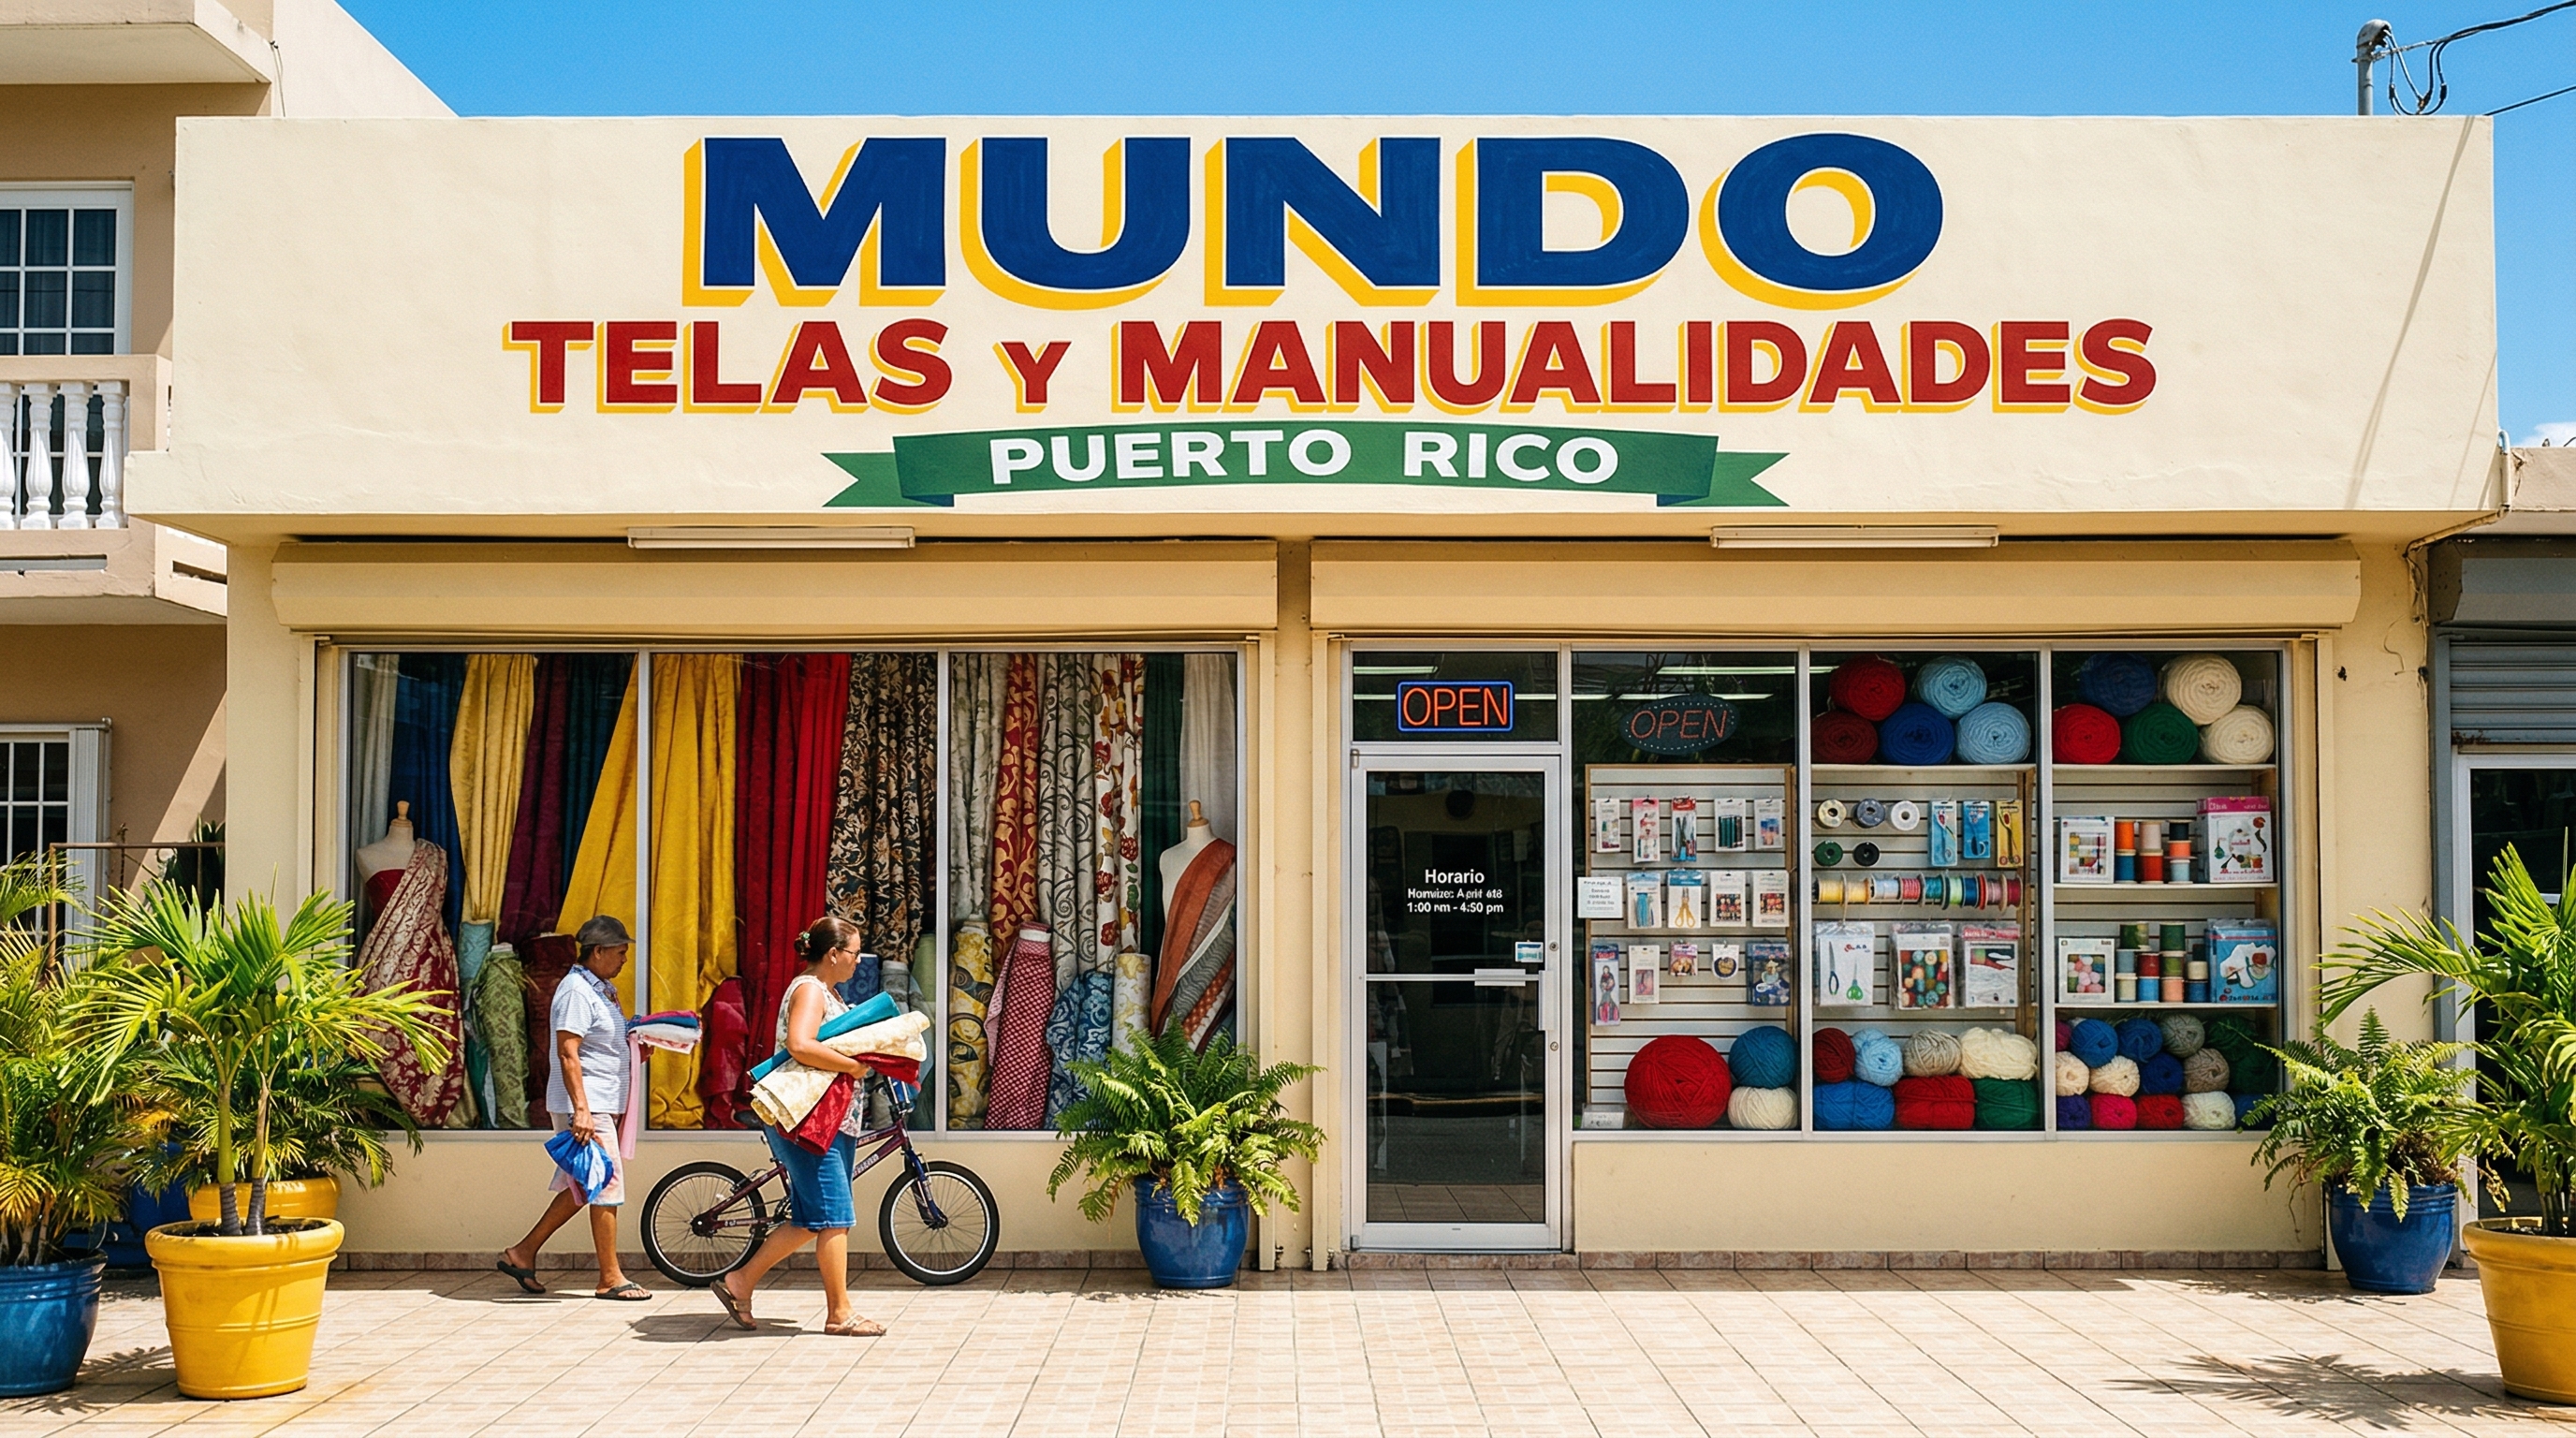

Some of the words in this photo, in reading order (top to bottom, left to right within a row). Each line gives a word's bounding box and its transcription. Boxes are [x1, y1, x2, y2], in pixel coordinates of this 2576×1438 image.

[682, 133, 1944, 310] MUNDO
[503, 318, 953, 415] TELAS
[994, 341, 1072, 415] Y
[1112, 318, 2158, 416] MANUALIDADES
[990, 428, 1351, 485] PUERTO
[1402, 432, 1619, 485] RICO
[1402, 687, 1508, 726] OPEN
[1631, 710, 1728, 740] OPEN
[1425, 869, 1486, 884] Horario
[1407, 902, 1432, 913] 1:00
[1486, 903, 1504, 916] pm
